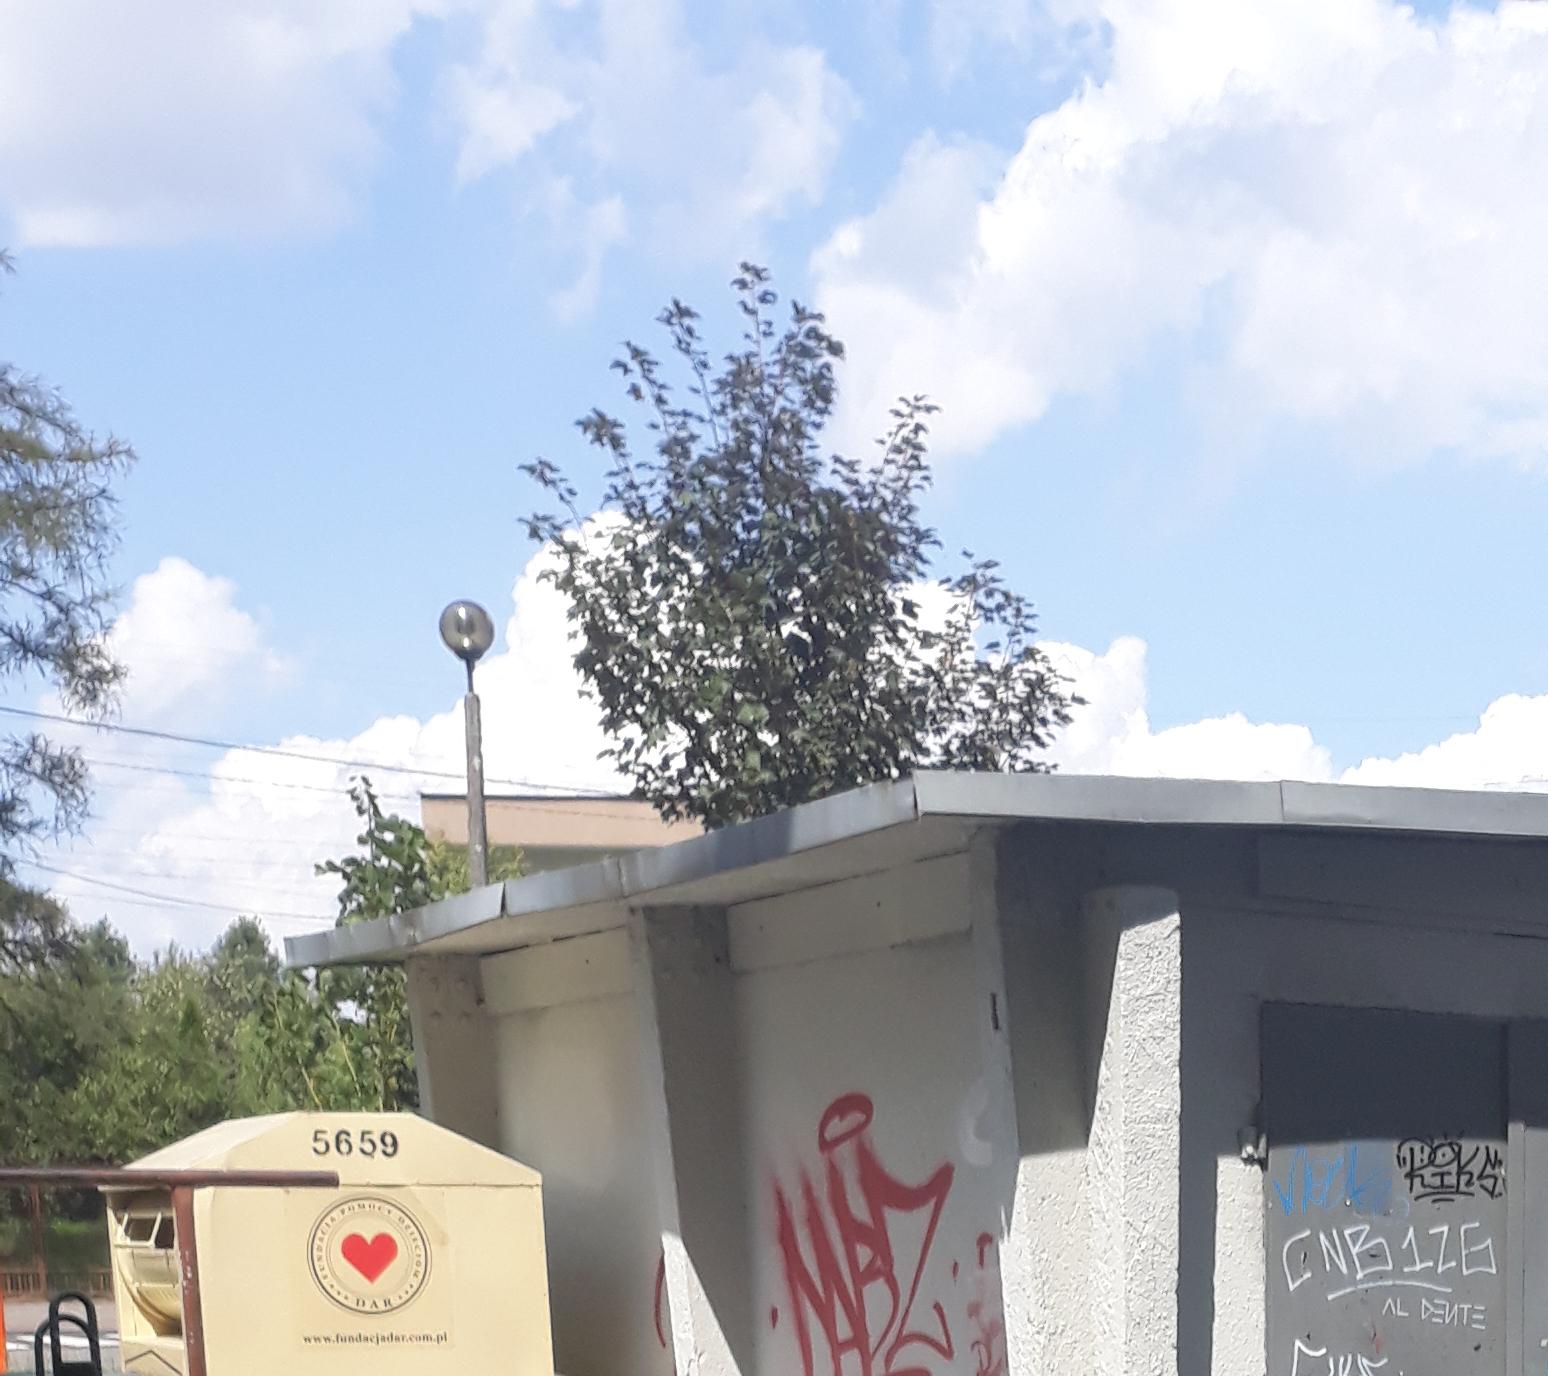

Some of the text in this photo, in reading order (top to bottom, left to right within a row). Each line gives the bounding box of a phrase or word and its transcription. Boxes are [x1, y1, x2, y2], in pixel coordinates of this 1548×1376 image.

[312, 1129, 398, 1157] 5659
[356, 1298, 393, 1309] DAR
[303, 1332, 448, 1346] www.fundacjadar.com.pl
